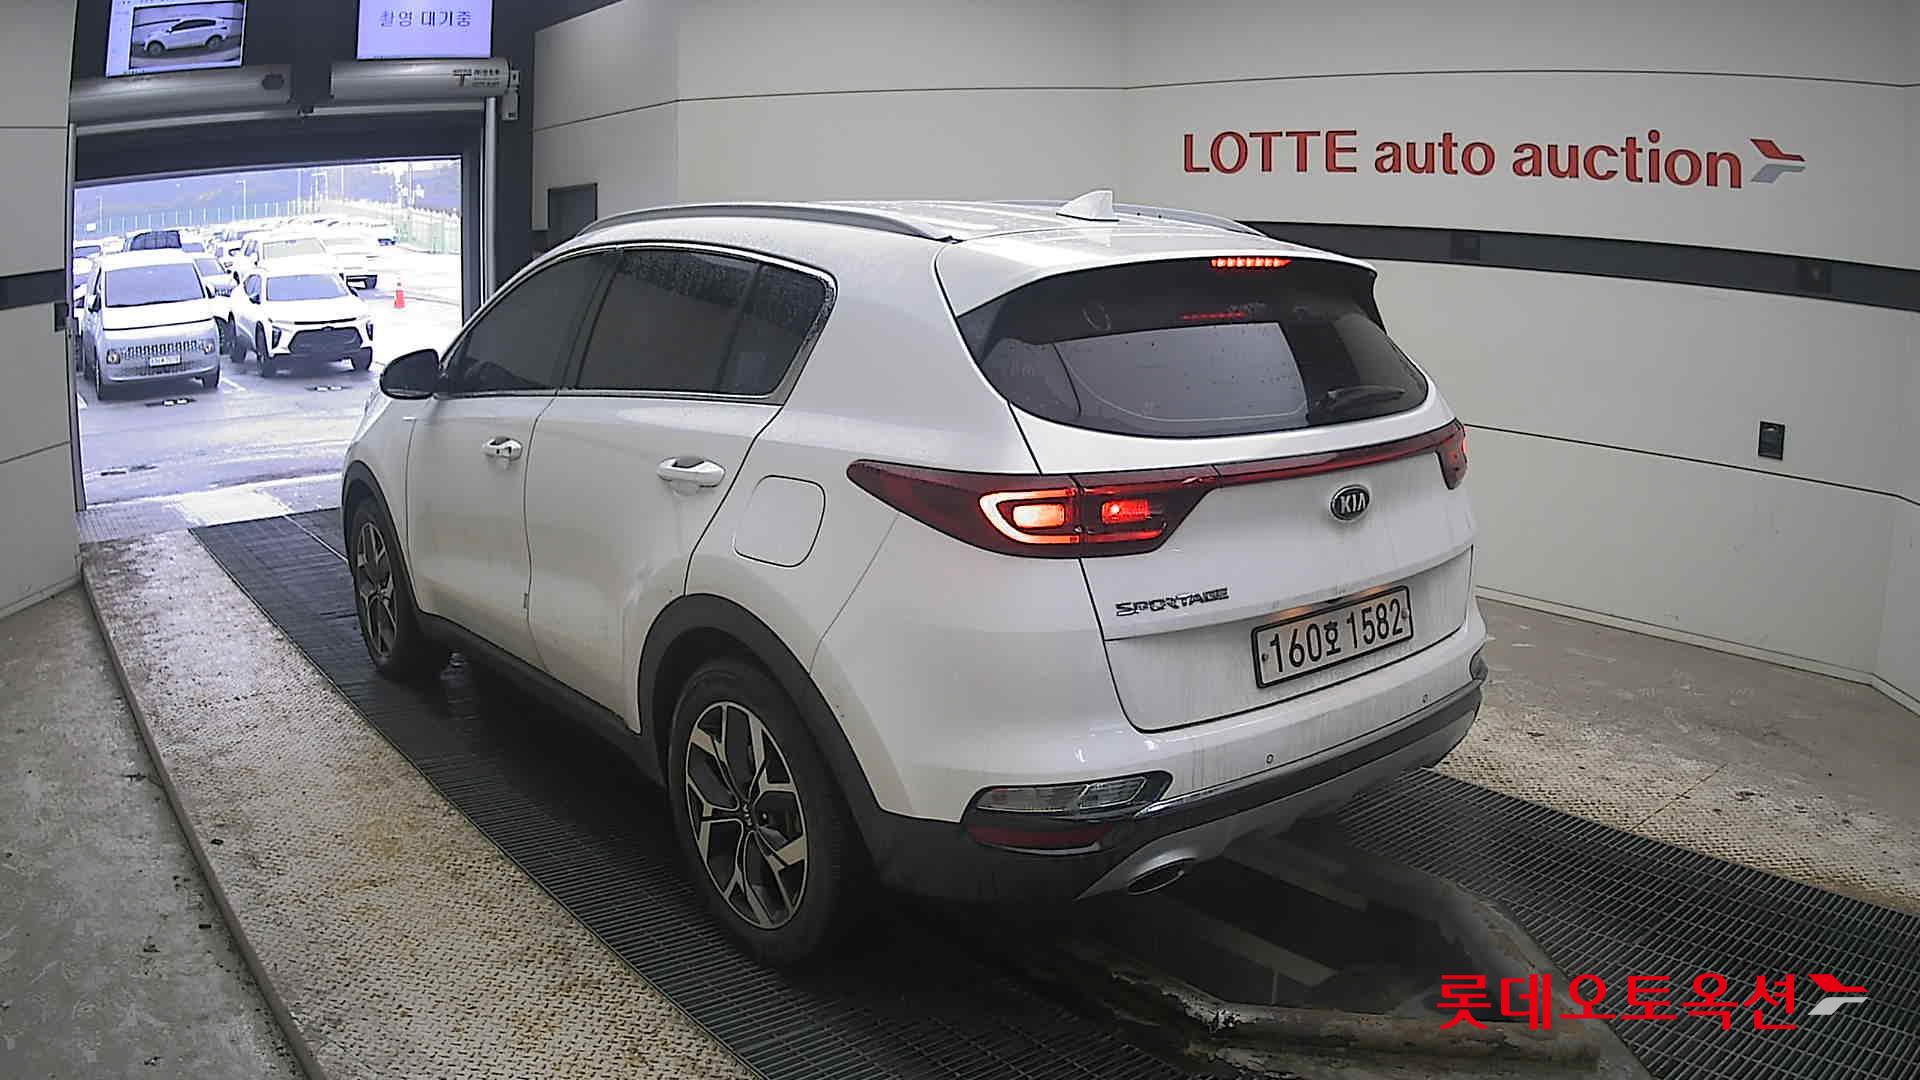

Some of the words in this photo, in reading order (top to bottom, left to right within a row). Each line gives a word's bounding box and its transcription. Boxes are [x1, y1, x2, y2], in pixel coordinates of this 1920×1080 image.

[420, 9, 472, 28] 대기중
[1183, 129, 1358, 175] LOTTE
[1374, 132, 1496, 176] auto
[1512, 129, 1743, 189] auction
[1115, 587, 1229, 616] SPORTAGE
